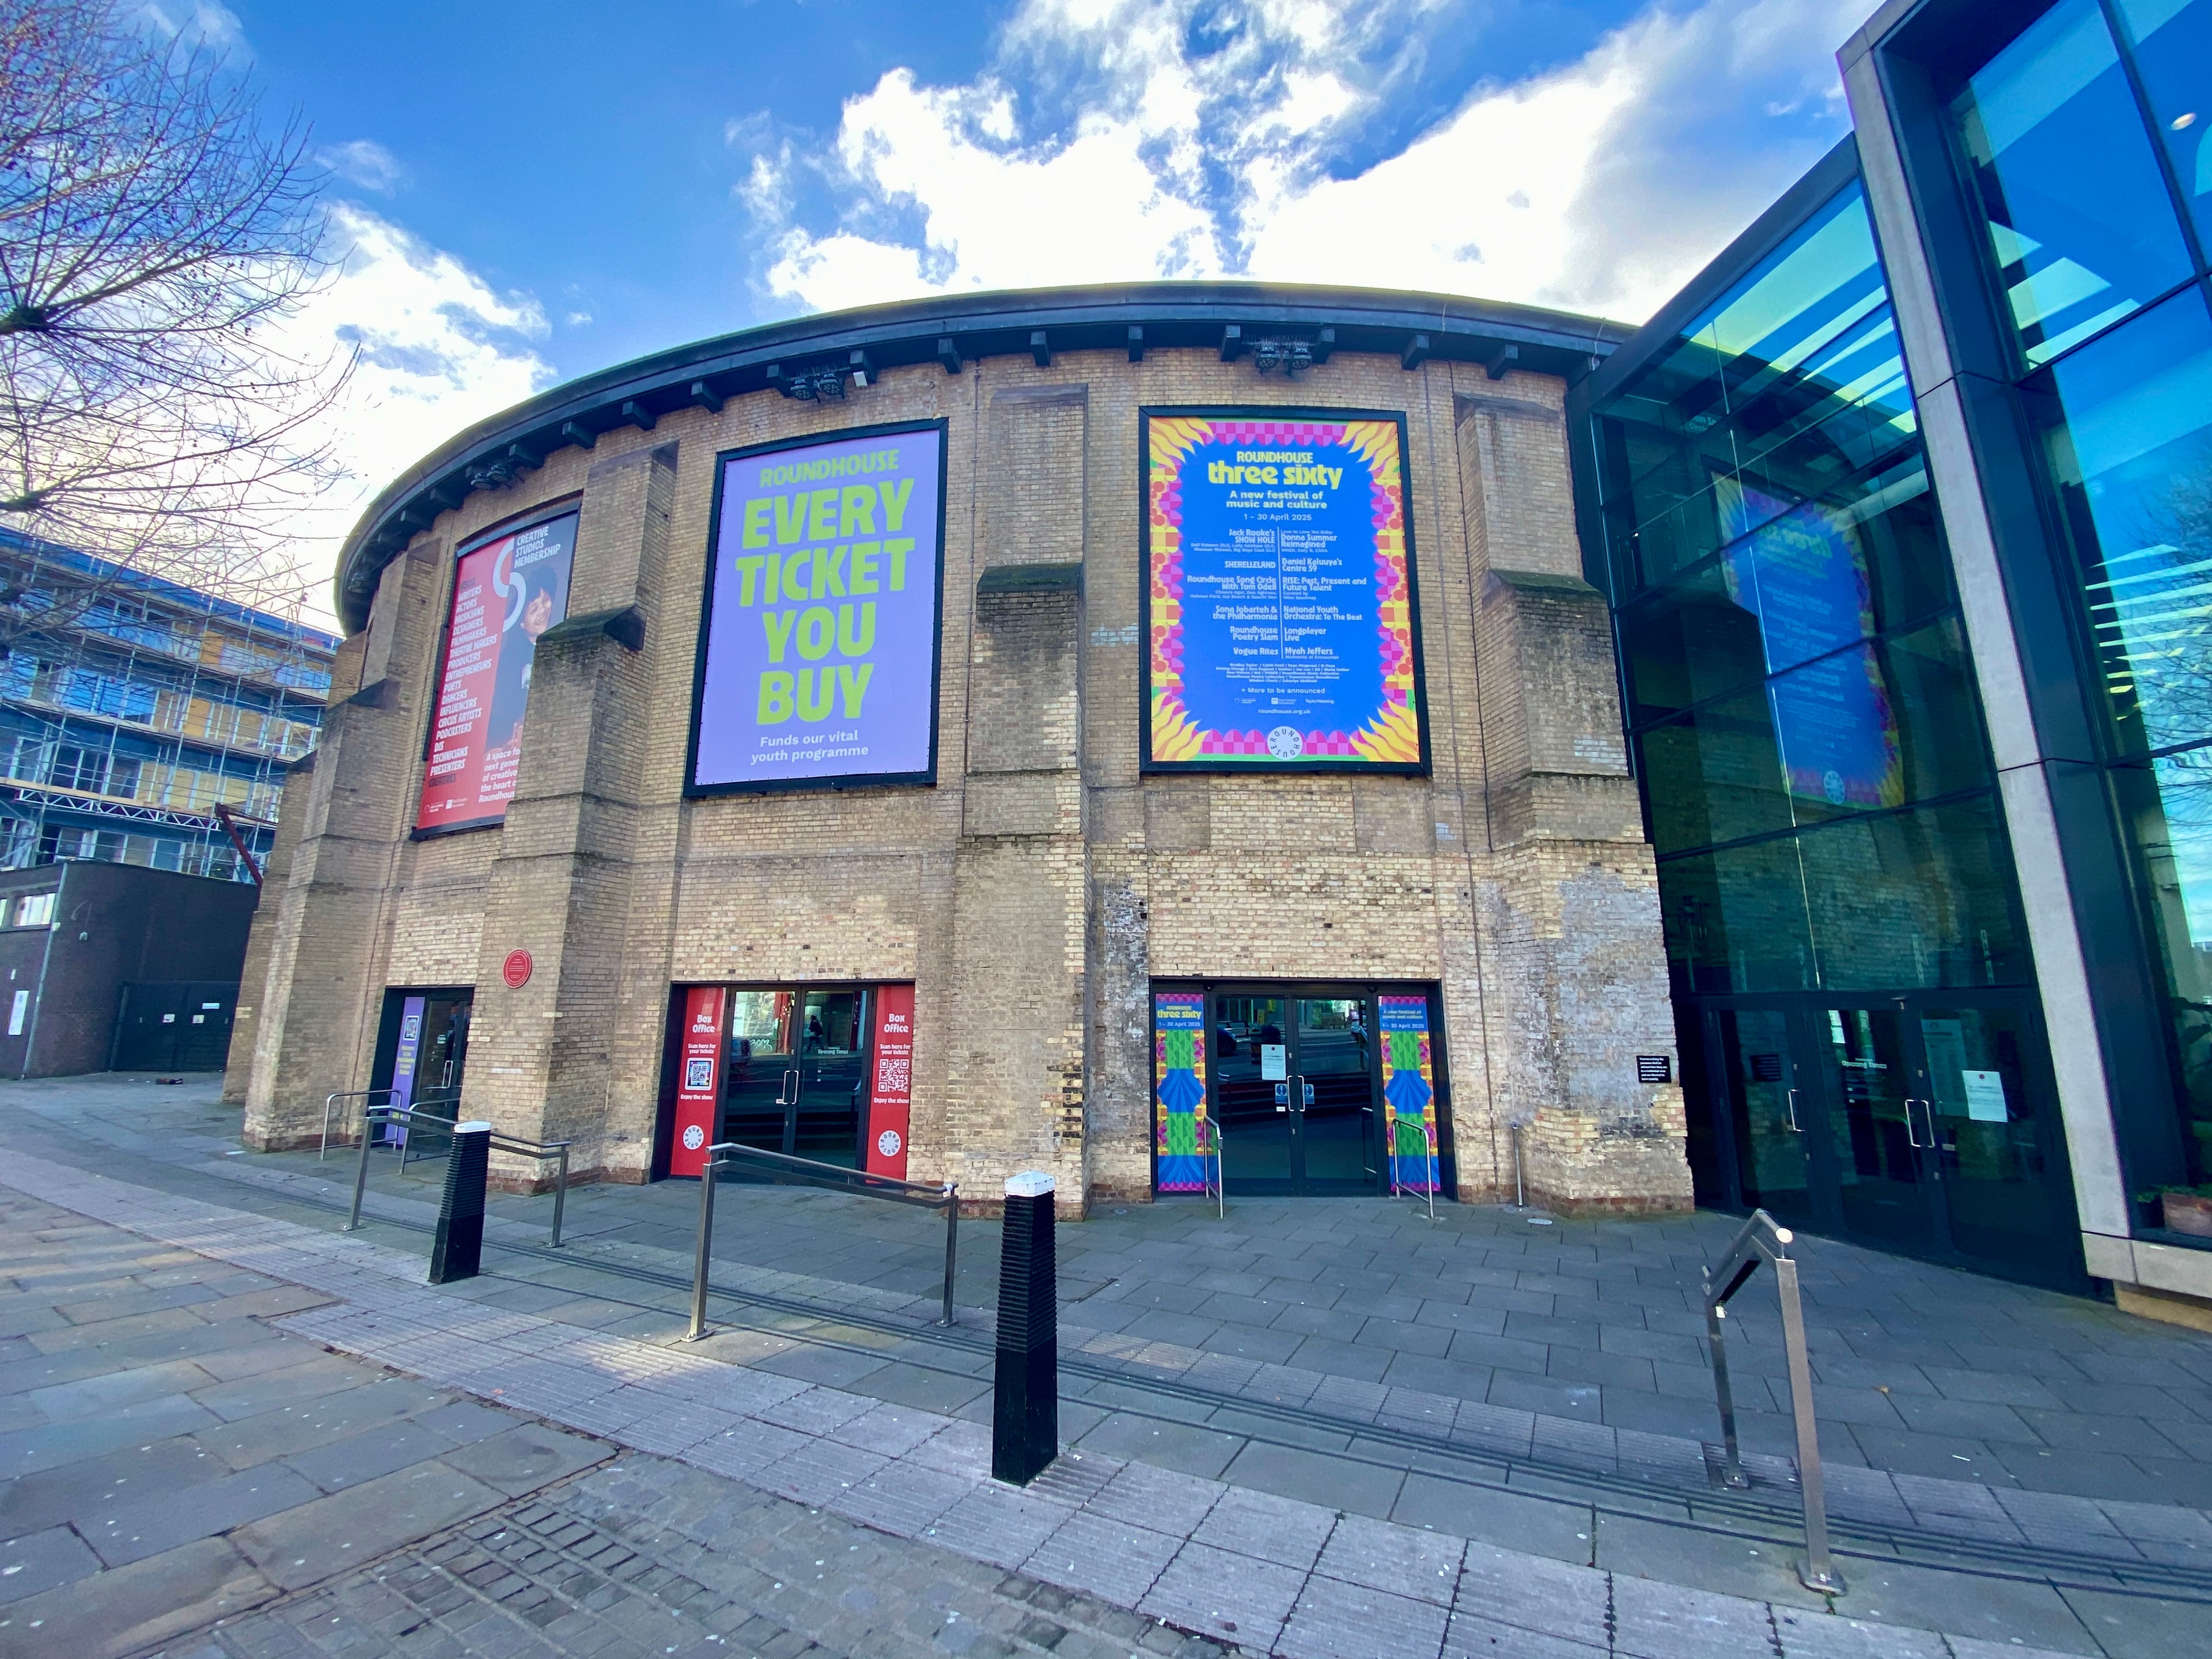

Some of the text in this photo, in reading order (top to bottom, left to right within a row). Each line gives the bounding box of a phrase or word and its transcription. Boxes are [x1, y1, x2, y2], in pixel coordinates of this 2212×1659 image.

[1237, 452, 1313, 464] ROUNDHOUSE
[760, 449, 900, 488] ROUNDHOUSE
[1209, 460, 1343, 490] three sixty
[1267, 490, 1309, 499] festival
[1312, 491, 1324, 499] of
[1226, 499, 1327, 509] music and culture
[742, 478, 915, 550] EVERY
[517, 525, 549, 546] CREATIVE
[514, 543, 560, 569] MEMBERSHIP
[516, 538, 544, 558] STUDIOS
[735, 538, 915, 607] TICKET
[1225, 560, 1276, 569] SHERELLELAND
[1187, 575, 1234, 583] Roundhouse
[1236, 575, 1255, 584] Song
[459, 585, 482, 603] WRITERS
[456, 597, 477, 613] ACTORS
[1236, 606, 1270, 614] Jobarteh
[1283, 605, 1315, 613] National
[454, 605, 484, 624] MUSICIANS
[1227, 612, 1278, 620] Philharmonia
[453, 617, 484, 636] DESIGNERS
[762, 601, 876, 664] YOU
[1230, 626, 1278, 634] Roundhouse
[1284, 627, 1327, 636] Longplayer
[452, 627, 487, 647] FILMMAKERS
[1233, 634, 1259, 642] Poetry
[450, 634, 498, 658] THEATRE MAKERS
[1233, 647, 1279, 656] Vogue Rites
[1285, 647, 1334, 656] Myah Jeffers
[448, 651, 481, 670] PRODUCERS
[445, 659, 491, 681] ENTREPRENEURS
[444, 680, 461, 693] POETS
[756, 663, 874, 725] BUY
[442, 689, 468, 704] DANCERS
[440, 698, 477, 717] INFLUENCERS
[438, 708, 482, 728] CIRCUS ARTISTS
[436, 722, 472, 741] PODCASTERS
[760, 730, 858, 748] Funds our vital
[1270, 729, 1300, 757] ROUNDHOUSE
[433, 747, 469, 764] TECHNICIANS
[492, 752, 510, 762] space
[751, 745, 869, 765] youth programme
[430, 759, 465, 777] PRESENTERS
[484, 763, 499, 771] next
[482, 774, 490, 782] of
[480, 781, 512, 793] the heart
[697, 1014, 712, 1023] Box
[889, 1013, 905, 1022] Box
[1157, 1009, 1181, 1018] three
[692, 1024, 715, 1033] Office
[884, 1024, 909, 1033] Office
